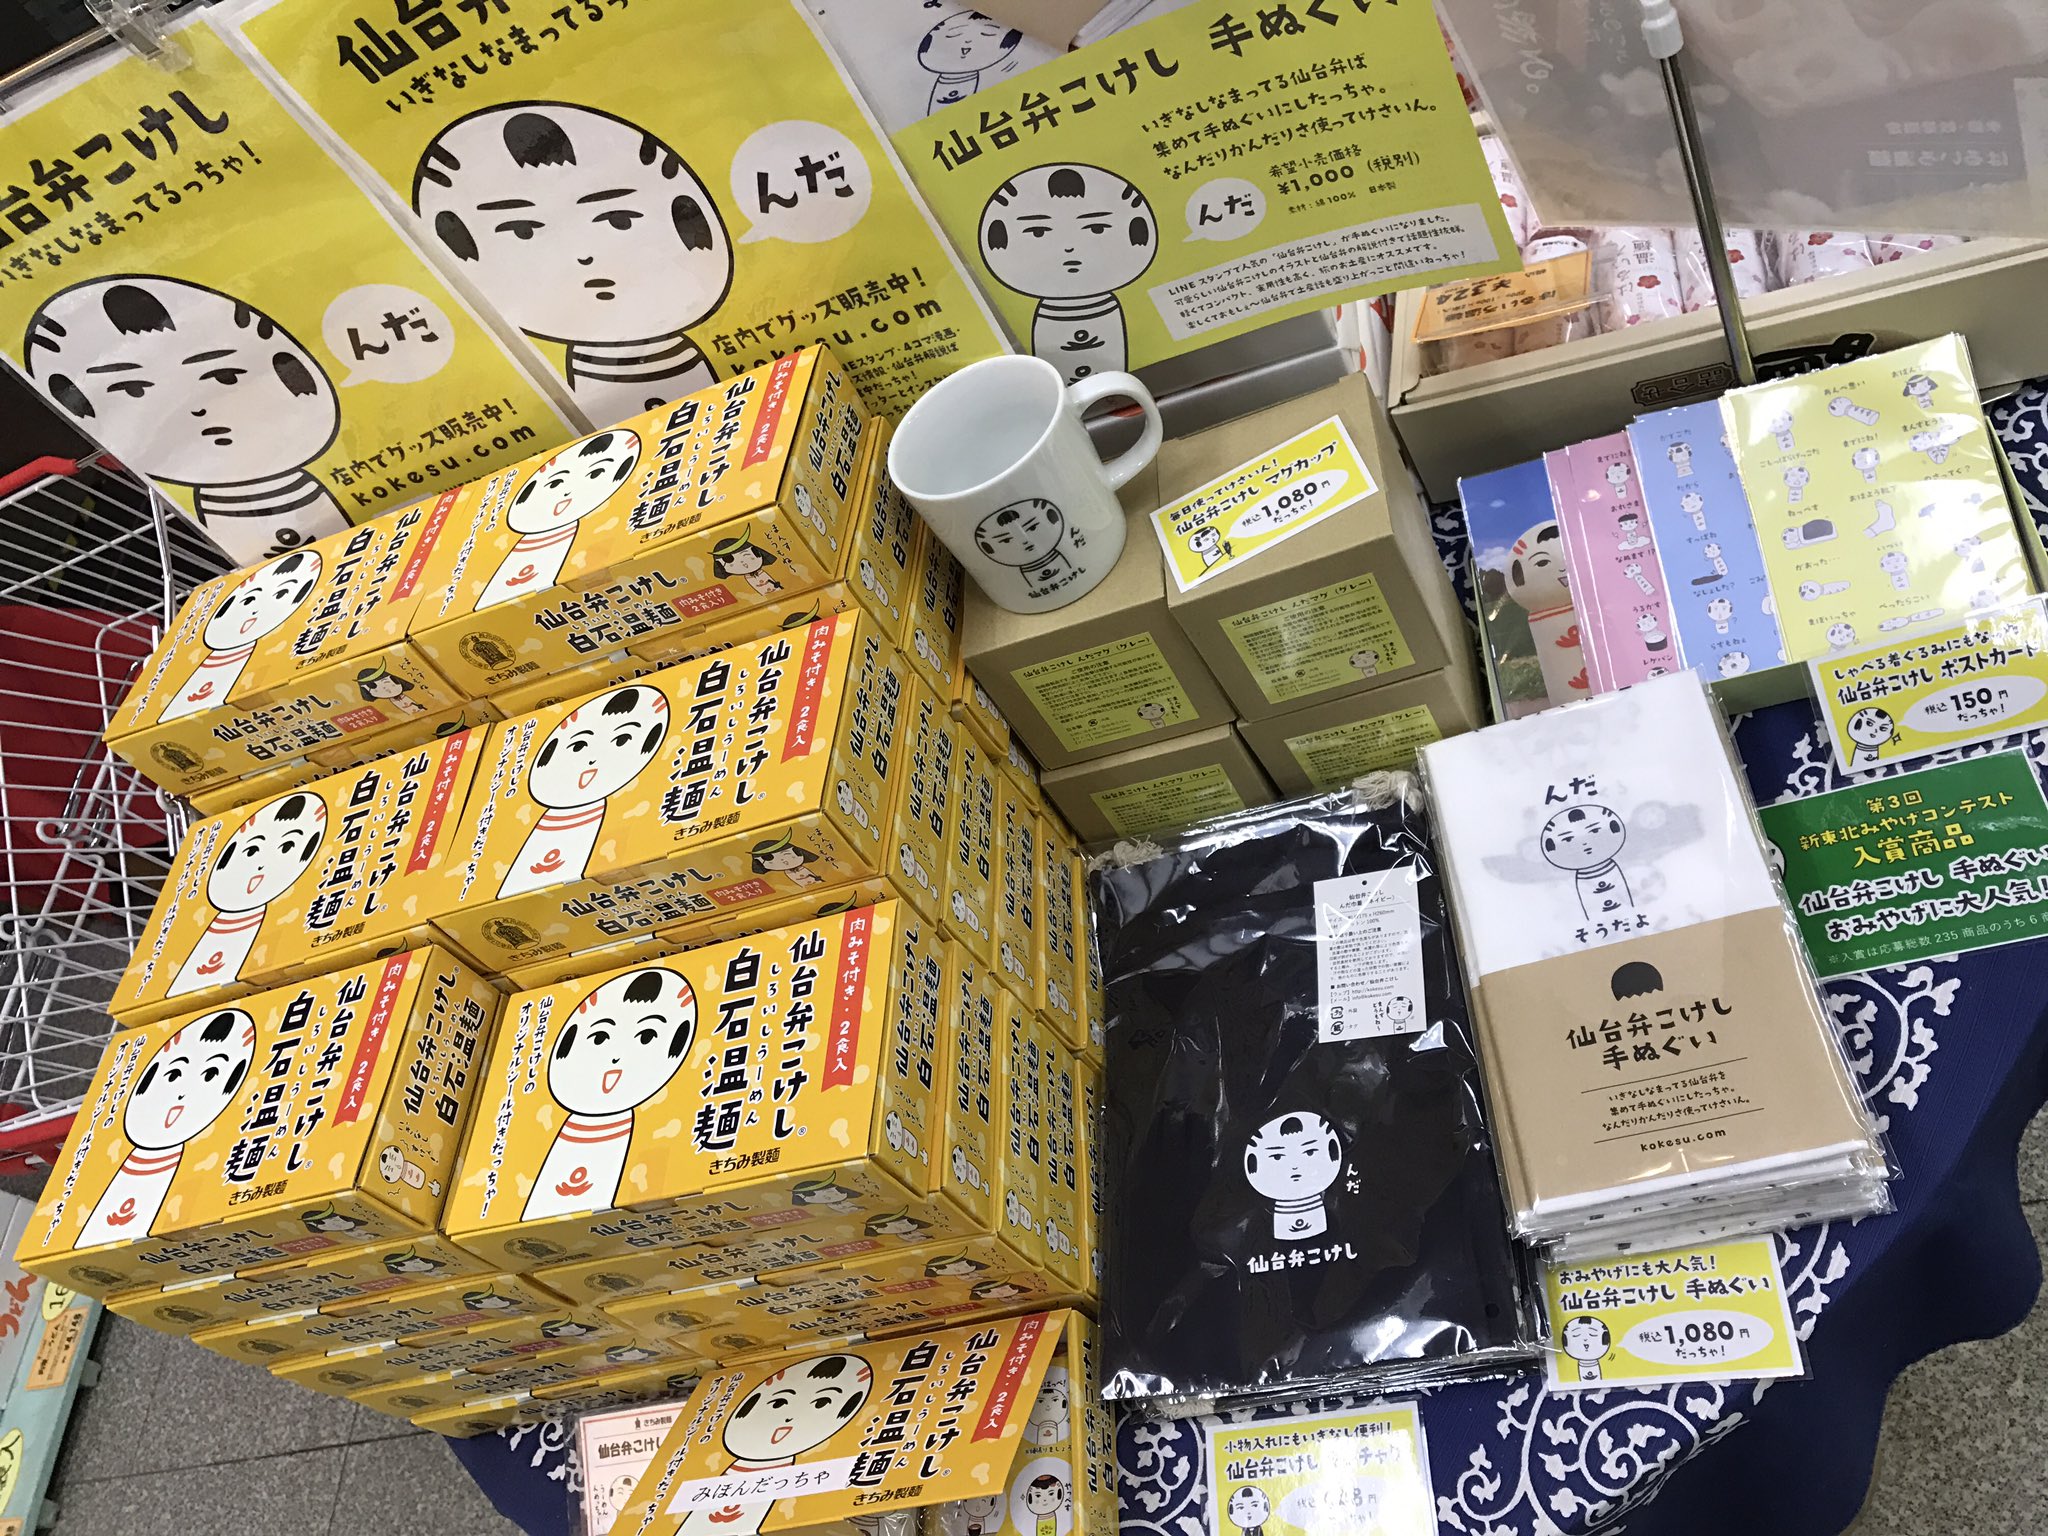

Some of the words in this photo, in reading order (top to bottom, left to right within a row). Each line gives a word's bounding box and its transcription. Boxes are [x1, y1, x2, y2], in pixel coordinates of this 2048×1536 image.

[933, 49, 1179, 172] 仙台弁こけし
[1142, 53, 1368, 133] いぎなしなまってる仙台弁ば
[1153, 84, 1386, 157] 集めて手ぬぐいにしたっちゃ。
[0, 90, 229, 249] 台弁こけし
[1163, 99, 1437, 180] なんだりかんだりさ使ってけさいん。
[1268, 143, 1362, 178] 希望小売価格
[757, 151, 854, 213] んだ
[1199, 194, 1256, 226] んだ
[1277, 165, 1354, 195] ¥1,000
[712, 267, 927, 357] 店内でグッズ販売中!
[1168, 280, 1196, 296] LINE
[346, 307, 440, 361] んだ
[330, 399, 518, 487] 店内でグッズ販売中!
[698, 375, 756, 509] 仙台弁こけし
[752, 360, 791, 459] 肉みそ付き・2食入
[809, 371, 841, 473] 仙台弁こけし
[351, 425, 536, 507] kokesu.com
[629, 401, 699, 533] 白石温麺
[674, 404, 715, 507] しろいしうーめん
[1169, 458, 1278, 521] 毎日使ってけさいん!
[1175, 486, 1260, 535] 仙台弁こけし
[1264, 441, 1338, 484] マグカップ
[485, 468, 518, 532] 仙台弁こけしの
[1242, 513, 1262, 527] 税込
[1261, 482, 1317, 518] 1,080
[1321, 479, 1331, 489] 円
[1273, 499, 1314, 524] だっちゃ!
[347, 508, 422, 640] 仙台弁こけし
[400, 493, 454, 591] 肉みそ付き・2食入
[1070, 527, 1086, 549] んだ
[185, 582, 226, 645] 仙台弁こけしの
[293, 528, 375, 657] 白石温麺
[331, 533, 385, 635] しろいしうーめん
[533, 572, 678, 631] 仙台弁こけし
[1028, 566, 1086, 599] 仙台弁こけし
[213, 694, 333, 743] 仙台弁こけし
[791, 626, 829, 748] 肉みそ付き・2食入
[850, 636, 879, 758] 仙台弁こけし
[1838, 666, 1933, 705] 仙台弁こけし
[1924, 704, 1948, 715] 税込
[1950, 688, 1993, 711] 150
[1998, 689, 2009, 699] 円
[1957, 704, 2005, 723] だっちゃ!
[505, 718, 536, 799] 仙台弁こけしの
[661, 659, 731, 825] 白石温麺
[709, 669, 748, 799] しろいしうーめん
[735, 640, 790, 805] 仙台弁こけし
[414, 739, 462, 861] 肉みそ付き・2食入
[1545, 775, 1598, 805] んだ
[1799, 792, 2014, 851] 新東北みやげコンテスト
[1866, 790, 1923, 814] 第3回
[187, 821, 222, 899] 仙台弁こけしの
[305, 770, 381, 931] 白石温麺
[345, 781, 394, 906] しろいしうーめん
[363, 752, 429, 916] 仙台弁こけし
[1853, 823, 1975, 868] 入賞商品
[562, 866, 714, 917] 仙台弁こけし
[1575, 913, 1650, 943] そうだよ
[1801, 870, 1942, 914] 仙台弁こけし
[1935, 930, 1959, 944] 235
[1962, 918, 2026, 939] 商品のうち
[2030, 915, 2038, 926] 6
[830, 917, 865, 1071] 肉みそ付き・2食入
[895, 928, 919, 1078] 仙台弁こけし
[1565, 997, 1732, 1050] 仙台弁こけし
[345, 964, 403, 1110] 肉みそ付き・2食入
[402, 972, 458, 1116] 仙台弁こけし
[523, 995, 553, 1094] 仙台弁こけしの
[692, 947, 762, 1153] 白石温麺
[746, 963, 781, 1126] しろいしうーめん
[773, 930, 826, 1139] 仙台弁こけし
[1602, 1030, 1718, 1071] 手ぬぐい
[102, 1034, 147, 1129] 仙台弁こけしの
[222, 989, 316, 1184] 白石温麺
[267, 1004, 328, 1158] しろいしうーめん
[285, 974, 368, 1173] 仙台弁こけし
[1608, 1070, 1727, 1102] いぎなしなまってる仙台弁を
[1609, 1086, 1735, 1117] 集めて手ぬぐいにしたっちゃ。
[1602, 1096, 1750, 1132] なんだりかんだりさ使ってけさいん。
[1640, 1128, 1727, 1153] kokesu.com
[1346, 1163, 1361, 1194] んだ
[138, 1228, 274, 1264] 仙台弁こけし
[590, 1200, 752, 1238] 仙台弁こけし
[1247, 1243, 1358, 1274] 仙台弁こけし
[1559, 1255, 1717, 1285] おみやげにも大人気!
[1560, 1282, 1676, 1311] 仙台弁こけし
[1686, 1276, 1769, 1300] 手ぬぐい
[1639, 1330, 1663, 1343] 税込
[1664, 1320, 1734, 1348] 1,080
[1739, 1327, 1750, 1339] 円
[1676, 1345, 1726, 1358] だっちゃ!
[698, 1371, 744, 1443] 仙台弁こけしの
[894, 1351, 954, 1468] しろいしうーめん
[918, 1328, 1000, 1480] 仙台弁こけし
[983, 1320, 1040, 1430] 肉みそ付き・2食入
[846, 1340, 940, 1489] 白石温麺
[1224, 1421, 1392, 1453] 小物入れにもいぎなし便利!
[692, 1470, 830, 1503] みほんだっちゃ
[1226, 1456, 1318, 1481] 仙台弁こけし
